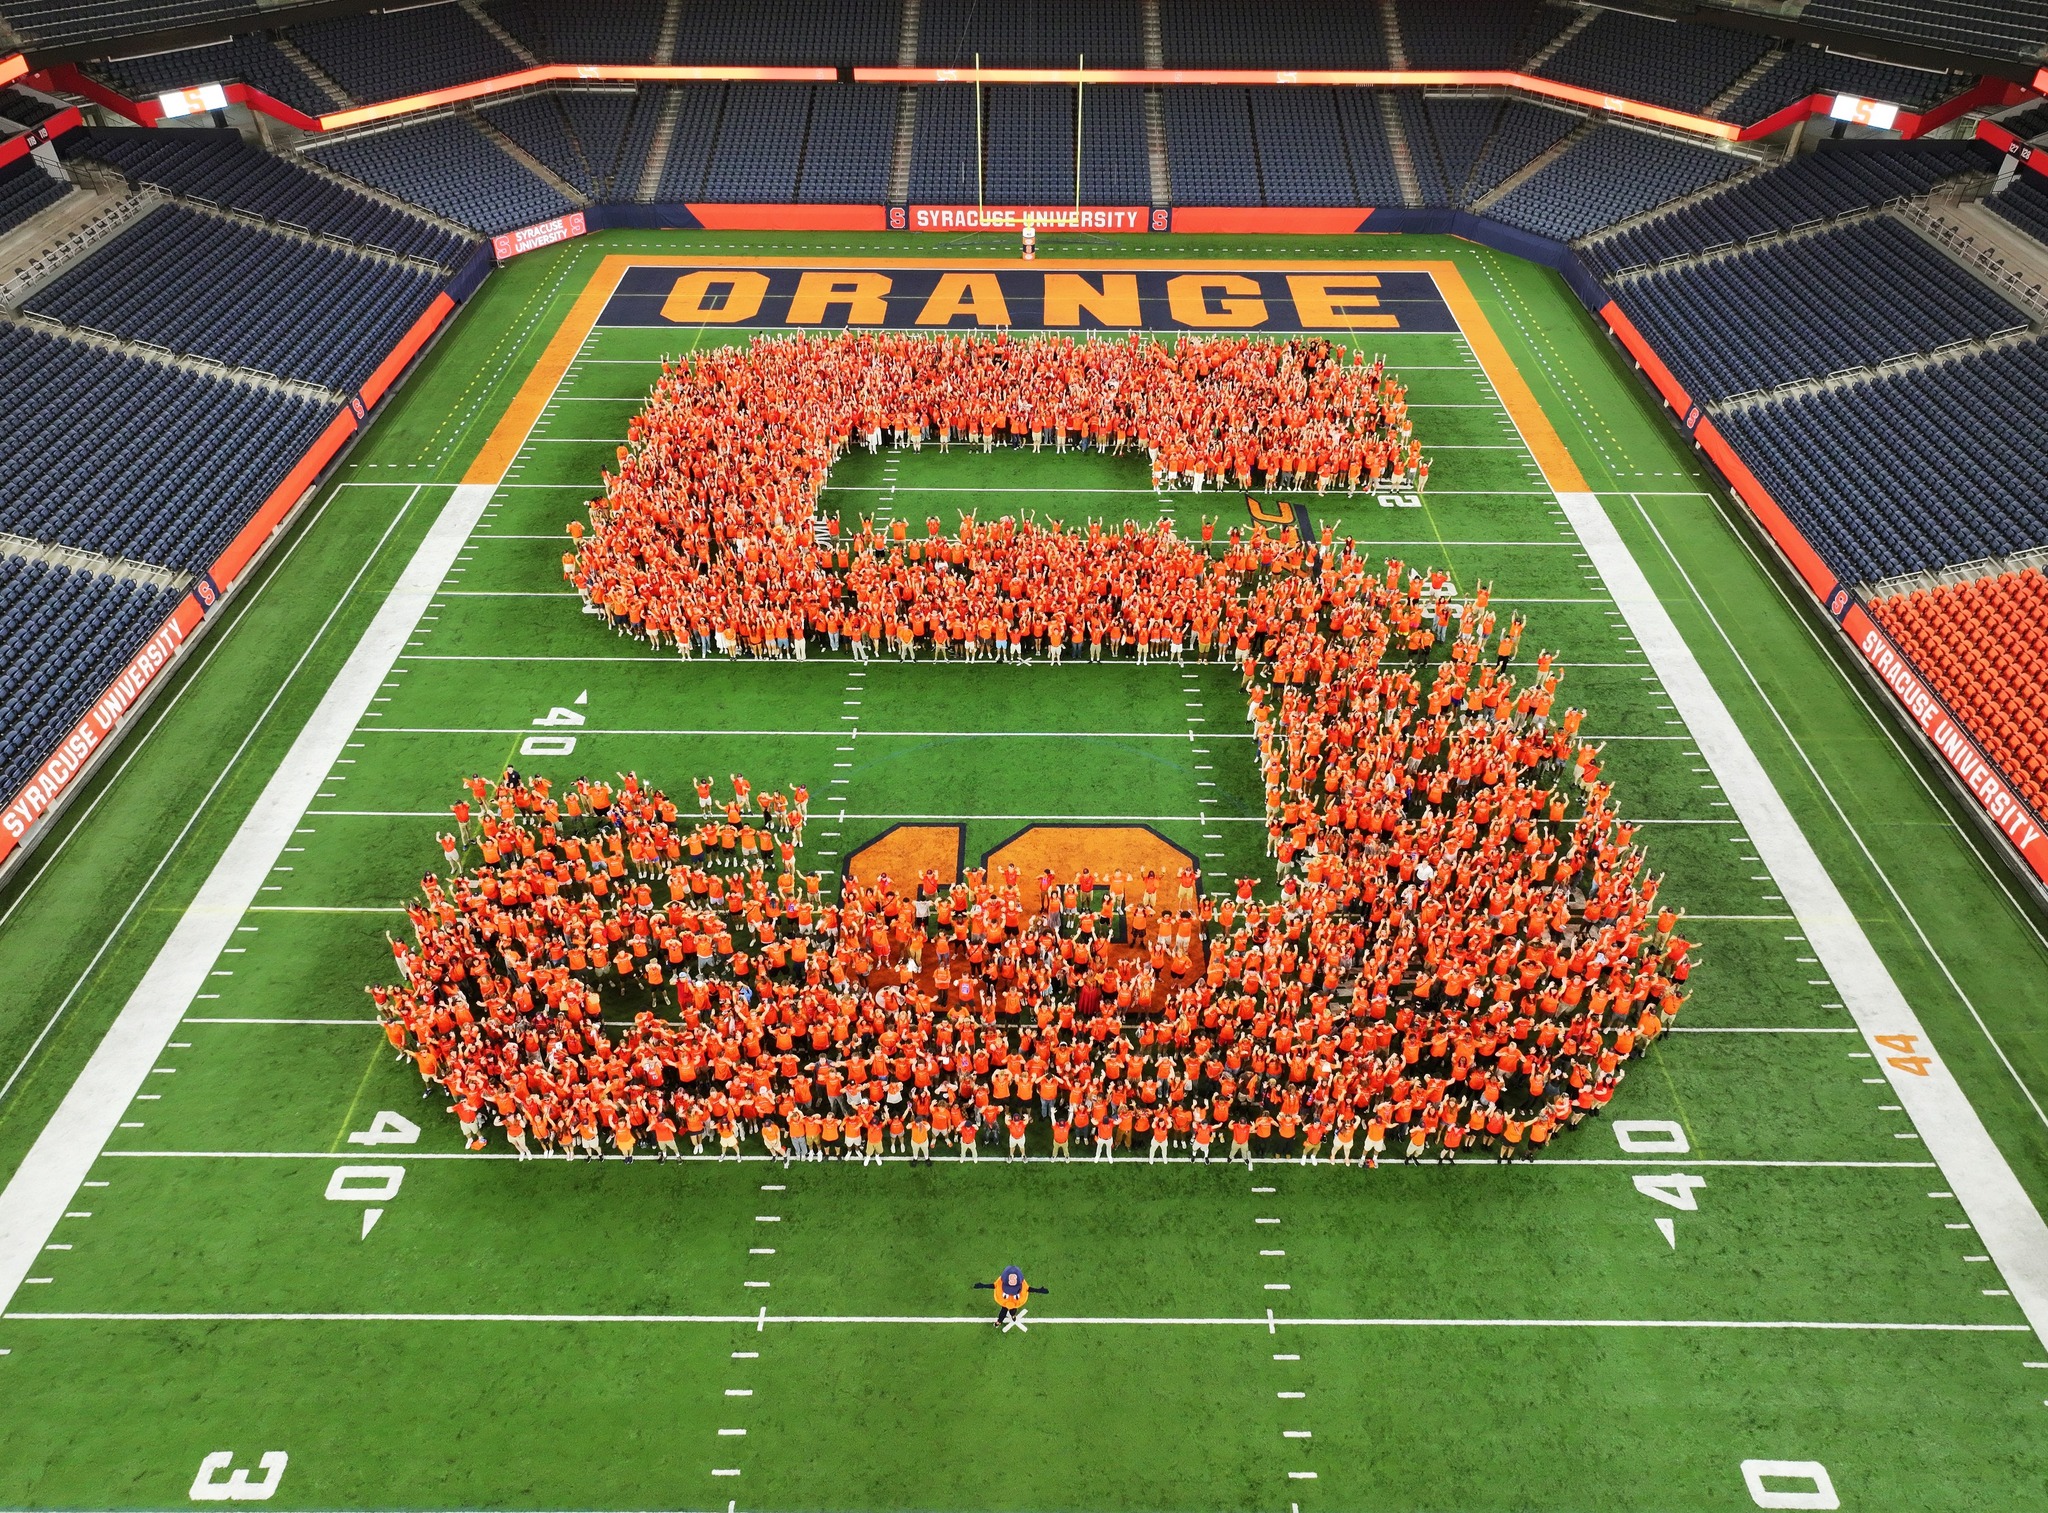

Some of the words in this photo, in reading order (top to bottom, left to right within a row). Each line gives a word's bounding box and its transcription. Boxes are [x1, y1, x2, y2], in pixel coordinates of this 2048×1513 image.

[182, 86, 207, 115] S
[1851, 97, 1877, 126] S
[515, 219, 564, 242] SYRACUSE
[570, 212, 586, 236] S
[890, 207, 906, 229] S
[916, 209, 1016, 227] SYRACUSE
[1029, 210, 1139, 228] UNIVERSITY
[1151, 208, 1168, 231] S
[494, 235, 512, 260] S
[515, 228, 568, 253] UNIVERSITY
[659, 270, 1402, 328] ORANGE
[198, 581, 217, 608] S
[1831, 589, 1849, 616] S
[2, 723, 99, 839] SYRACUSE
[96, 617, 184, 731] UNIVERSITY
[519, 706, 587, 757] 40
[1861, 630, 1940, 728] SYRACUSE
[1934, 716, 2041, 851] UNIVERSITY
[1874, 1033, 1933, 1077] 44
[325, 1110, 422, 1202] 40
[1611, 1119, 1708, 1212] 40
[1007, 1273, 1018, 1287] S
[188, 1450, 290, 1502] 3
[1740, 1458, 1842, 1511] 0
